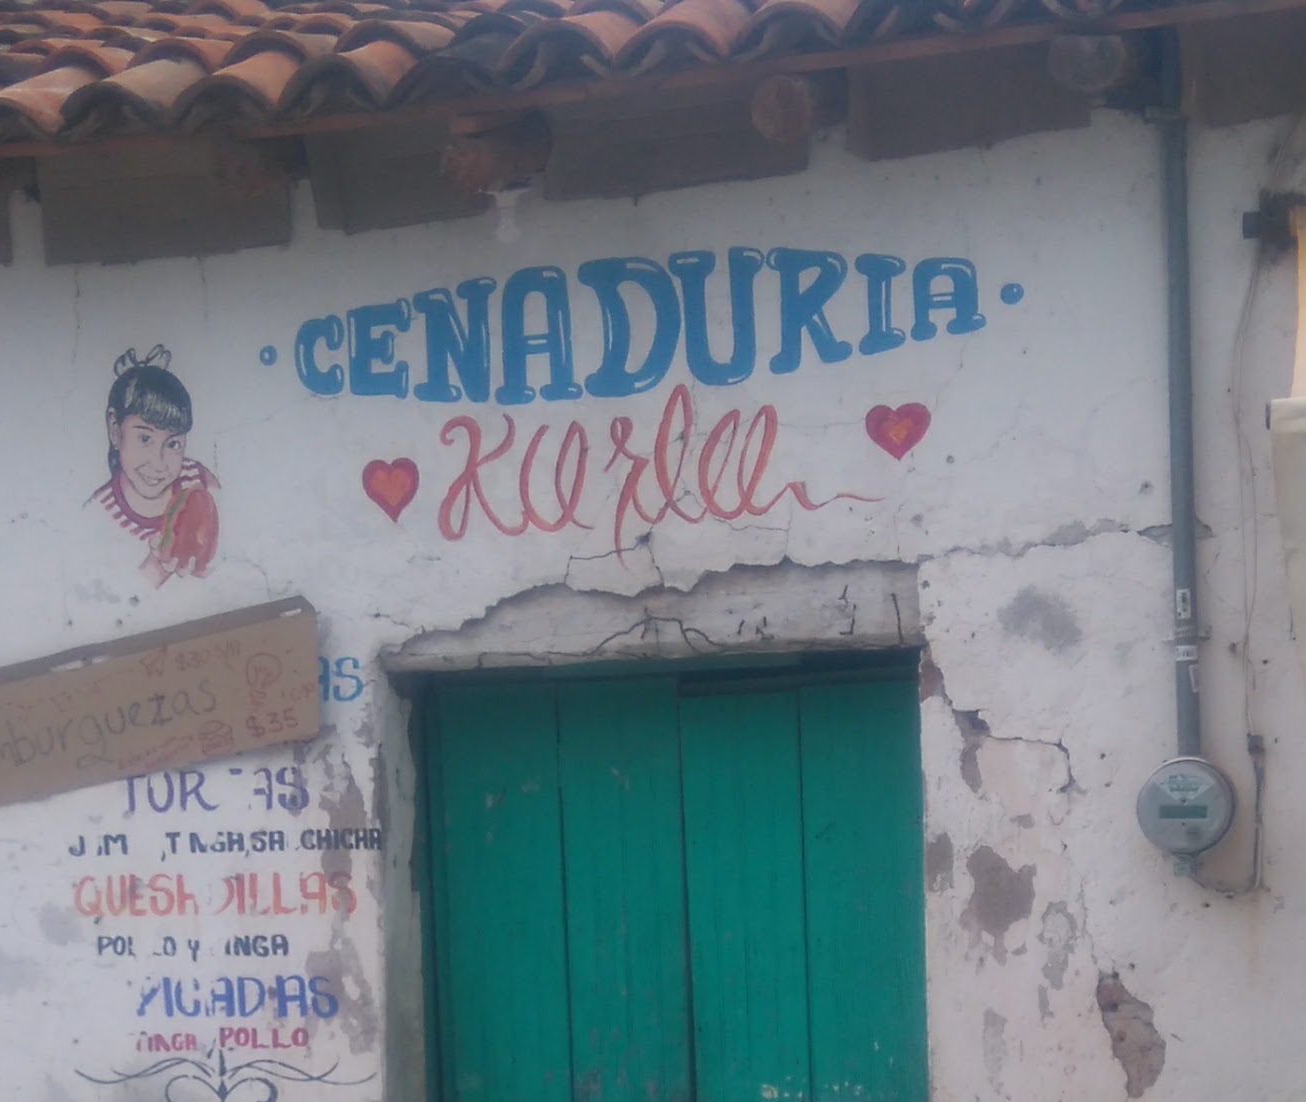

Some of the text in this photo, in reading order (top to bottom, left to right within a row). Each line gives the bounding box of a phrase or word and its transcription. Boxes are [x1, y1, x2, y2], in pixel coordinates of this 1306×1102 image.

[293, 245, 987, 406] CENADURIA
[123, 766, 310, 815] TORAS
[211, 933, 290, 958] INGA
[218, 1025, 310, 1050] POLLO
